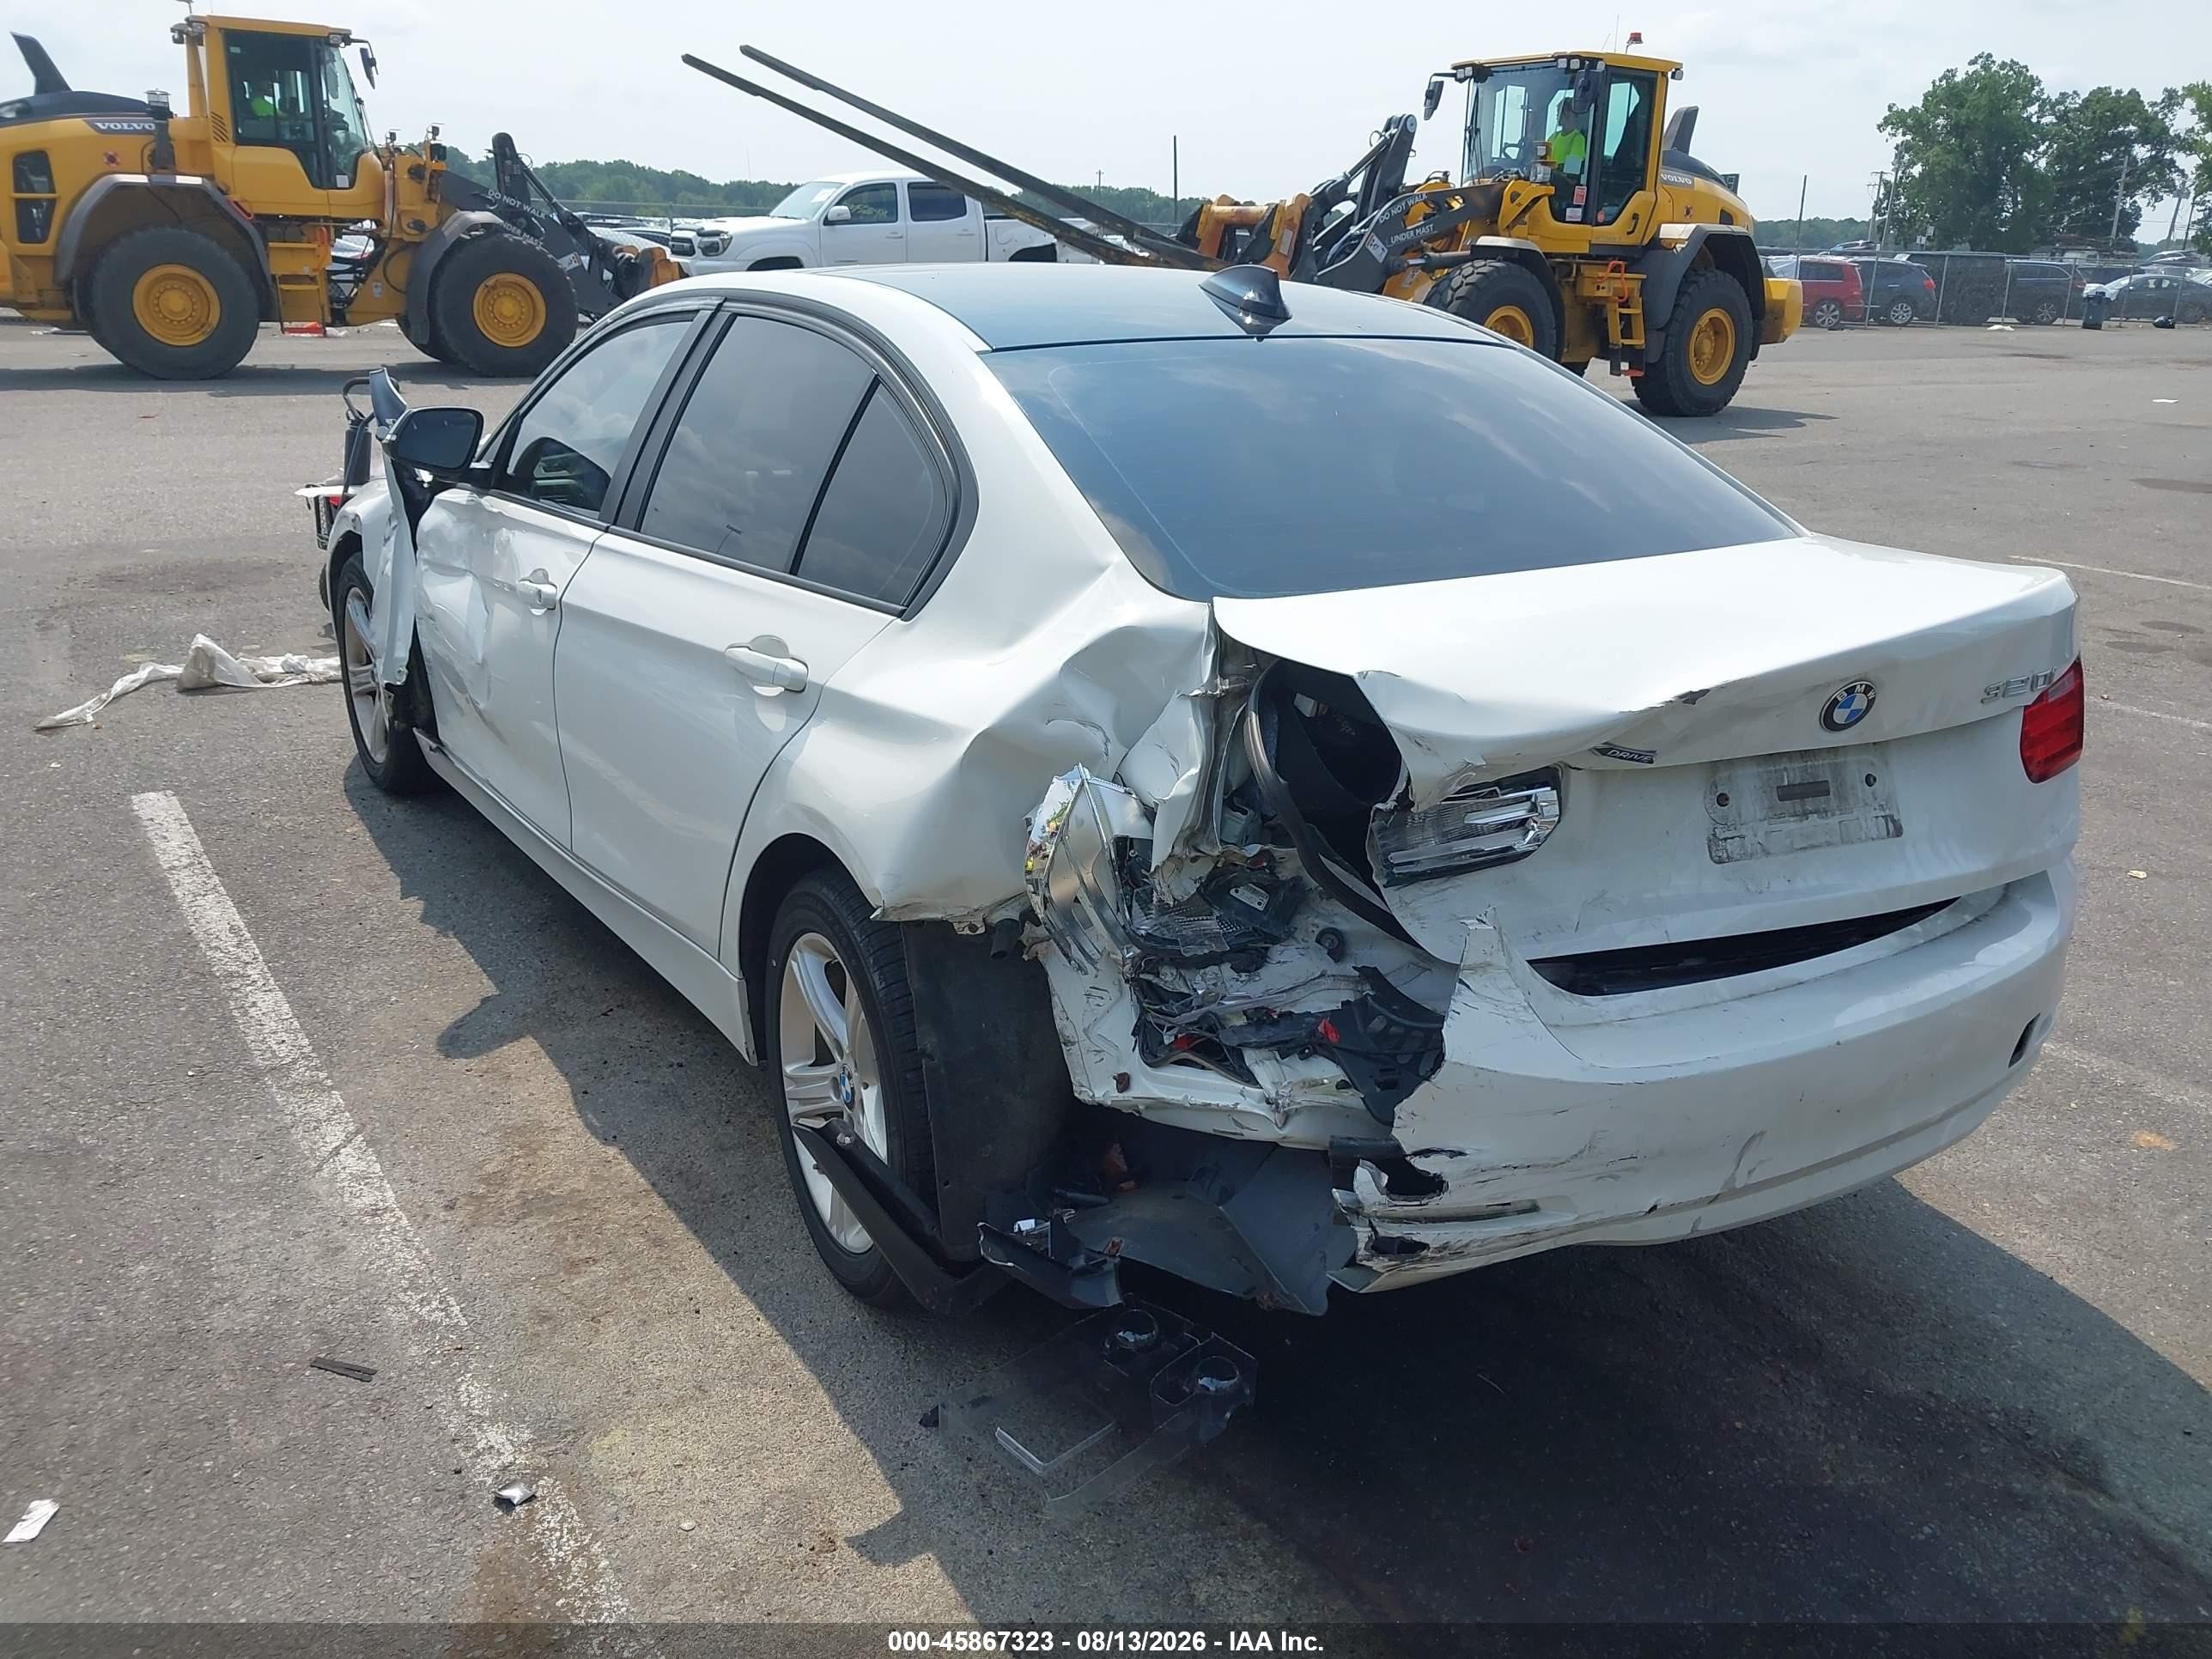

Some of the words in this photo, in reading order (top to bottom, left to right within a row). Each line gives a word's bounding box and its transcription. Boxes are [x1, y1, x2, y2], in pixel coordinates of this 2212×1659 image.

[1660, 173, 1692, 185] VOLVO
[488, 189, 501, 199] DO
[501, 195, 522, 209] NOT
[523, 204, 546, 220] WALK
[1379, 212, 1390, 223] DO
[1391, 202, 1407, 215] NOT
[1409, 192, 1428, 207] WALK
[499, 221, 522, 236] NDER
[1390, 233, 1415, 244] UNDER
[1415, 224, 1434, 236] MAST
[1607, 749, 1653, 763] DRIVE
